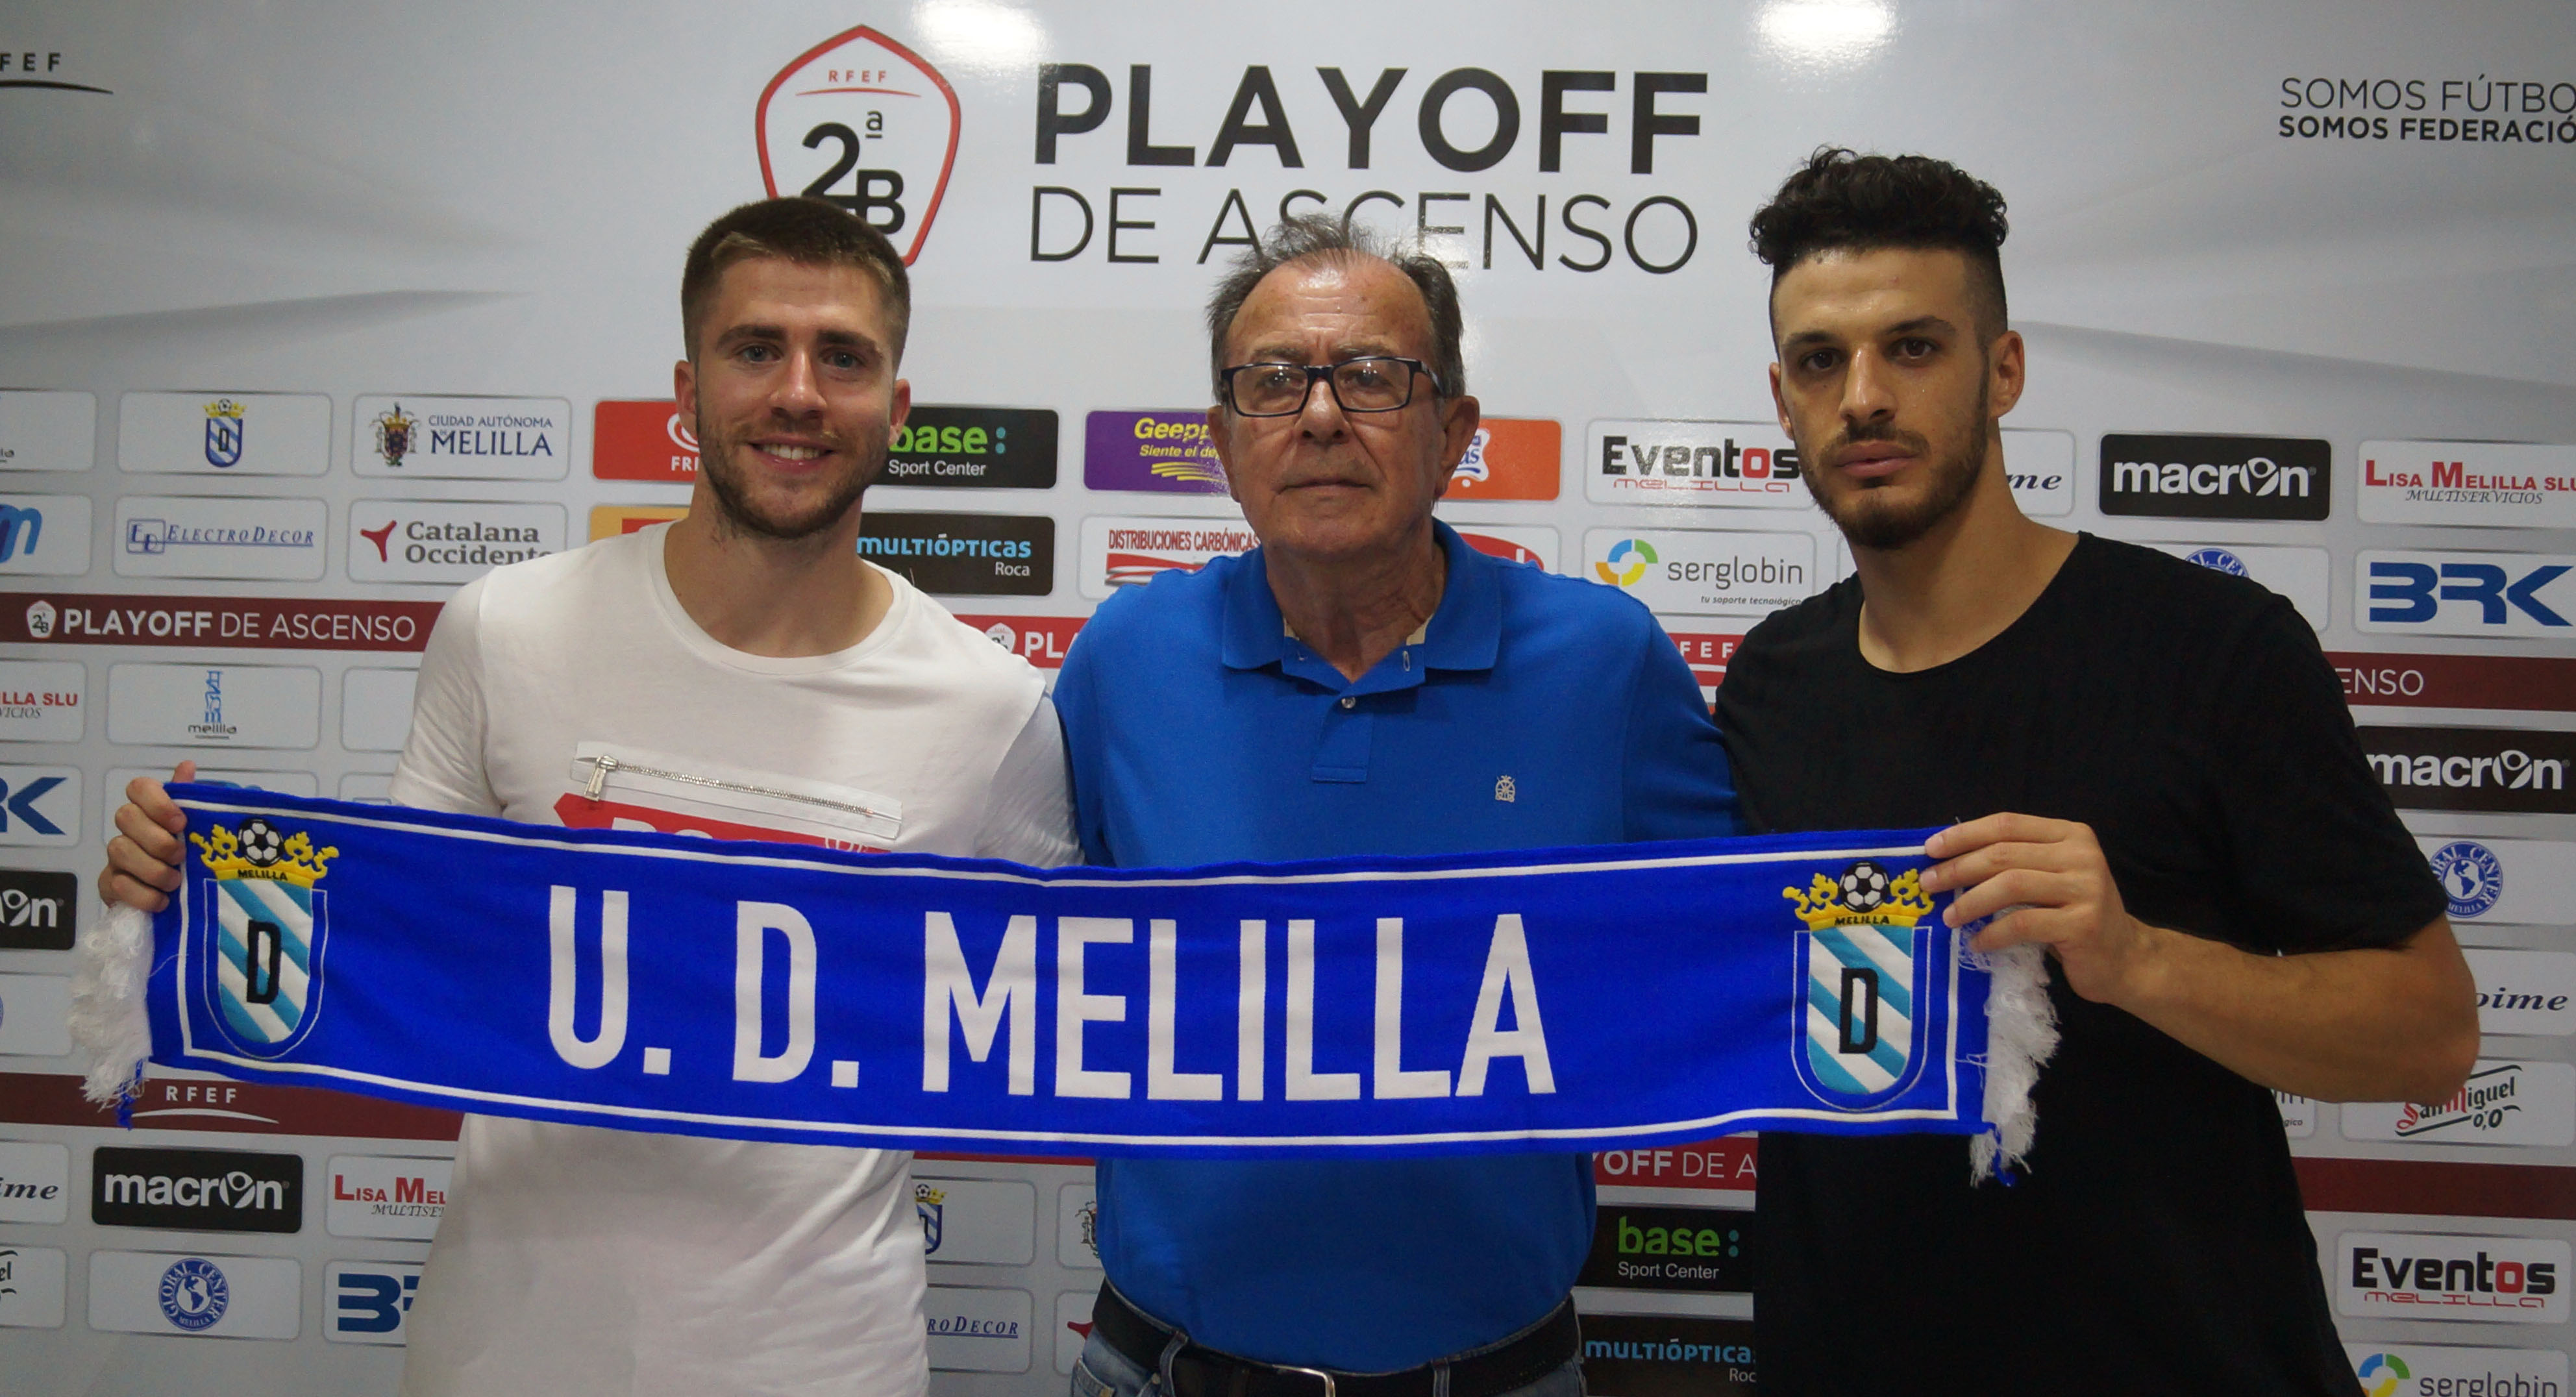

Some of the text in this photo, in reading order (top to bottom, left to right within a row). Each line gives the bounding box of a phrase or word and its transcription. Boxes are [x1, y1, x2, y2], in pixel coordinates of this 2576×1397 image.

[829, 69, 888, 83] RFEF
[2280, 77, 2427, 111] SOMOS
[1035, 63, 1708, 175] PLAYOFF
[2279, 116, 2388, 139] SOMOS
[1030, 186, 1161, 264] DE
[428, 414, 552, 428] CIUDAD AUTÓNOMA
[430, 429, 552, 456] MELILLA
[1140, 444, 1182, 458] Siente
[1184, 445, 1198, 458] el
[888, 459, 986, 476] Sport Center
[1602, 436, 1800, 478] Eventos
[2114, 457, 2309, 498] macron
[406, 521, 540, 543] Catalana
[1108, 527, 1261, 552] DISTRIBUCIONES CARBÓNICAS
[995, 562, 1030, 576] Roca
[1667, 555, 1803, 590] serglobin
[1700, 595, 1710, 604] tu
[1713, 597, 1747, 606] soporte
[2369, 562, 2575, 628] BRK
[64, 608, 415, 642] PLAYOFF DE ASCENSO
[42, 692, 78, 707] SLU
[237, 867, 288, 882] MELILLA
[1834, 915, 1890, 926] MELILLA
[245, 919, 282, 1004] D
[548, 884, 1557, 1102] U. D. MELILLA
[1839, 967, 1879, 1054] D
[166, 1085, 237, 1103] RFEF
[1683, 1151, 1726, 1178] DE
[105, 1170, 283, 1209] macron
[1618, 1261, 1720, 1280] Sport Center
[2352, 1247, 2556, 1294] Eventos
[2420, 1371, 2558, 1397] serglobin
